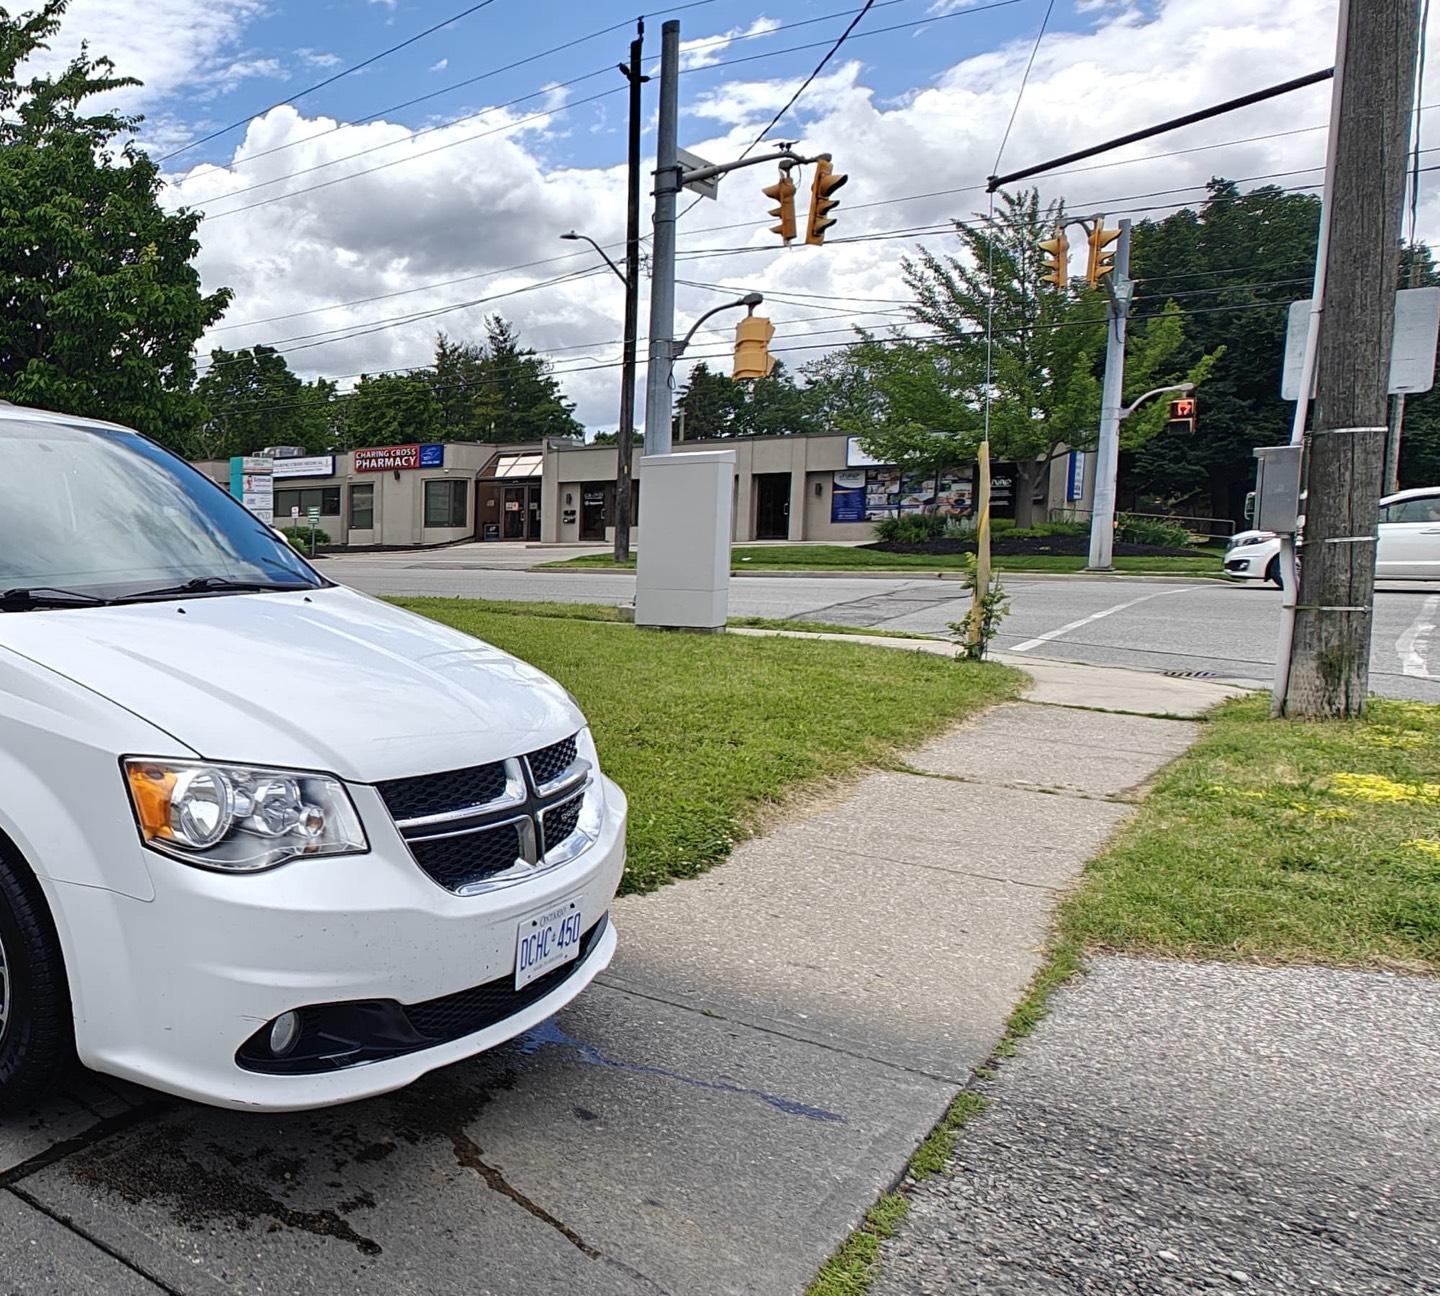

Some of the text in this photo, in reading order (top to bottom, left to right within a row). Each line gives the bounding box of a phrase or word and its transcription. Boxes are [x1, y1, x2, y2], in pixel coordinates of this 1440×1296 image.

[356, 448, 416, 459] CHARING CROSS
[355, 456, 416, 469] PHARMACY
[520, 926, 552, 972] DCHC
[557, 911, 581, 949] 450
